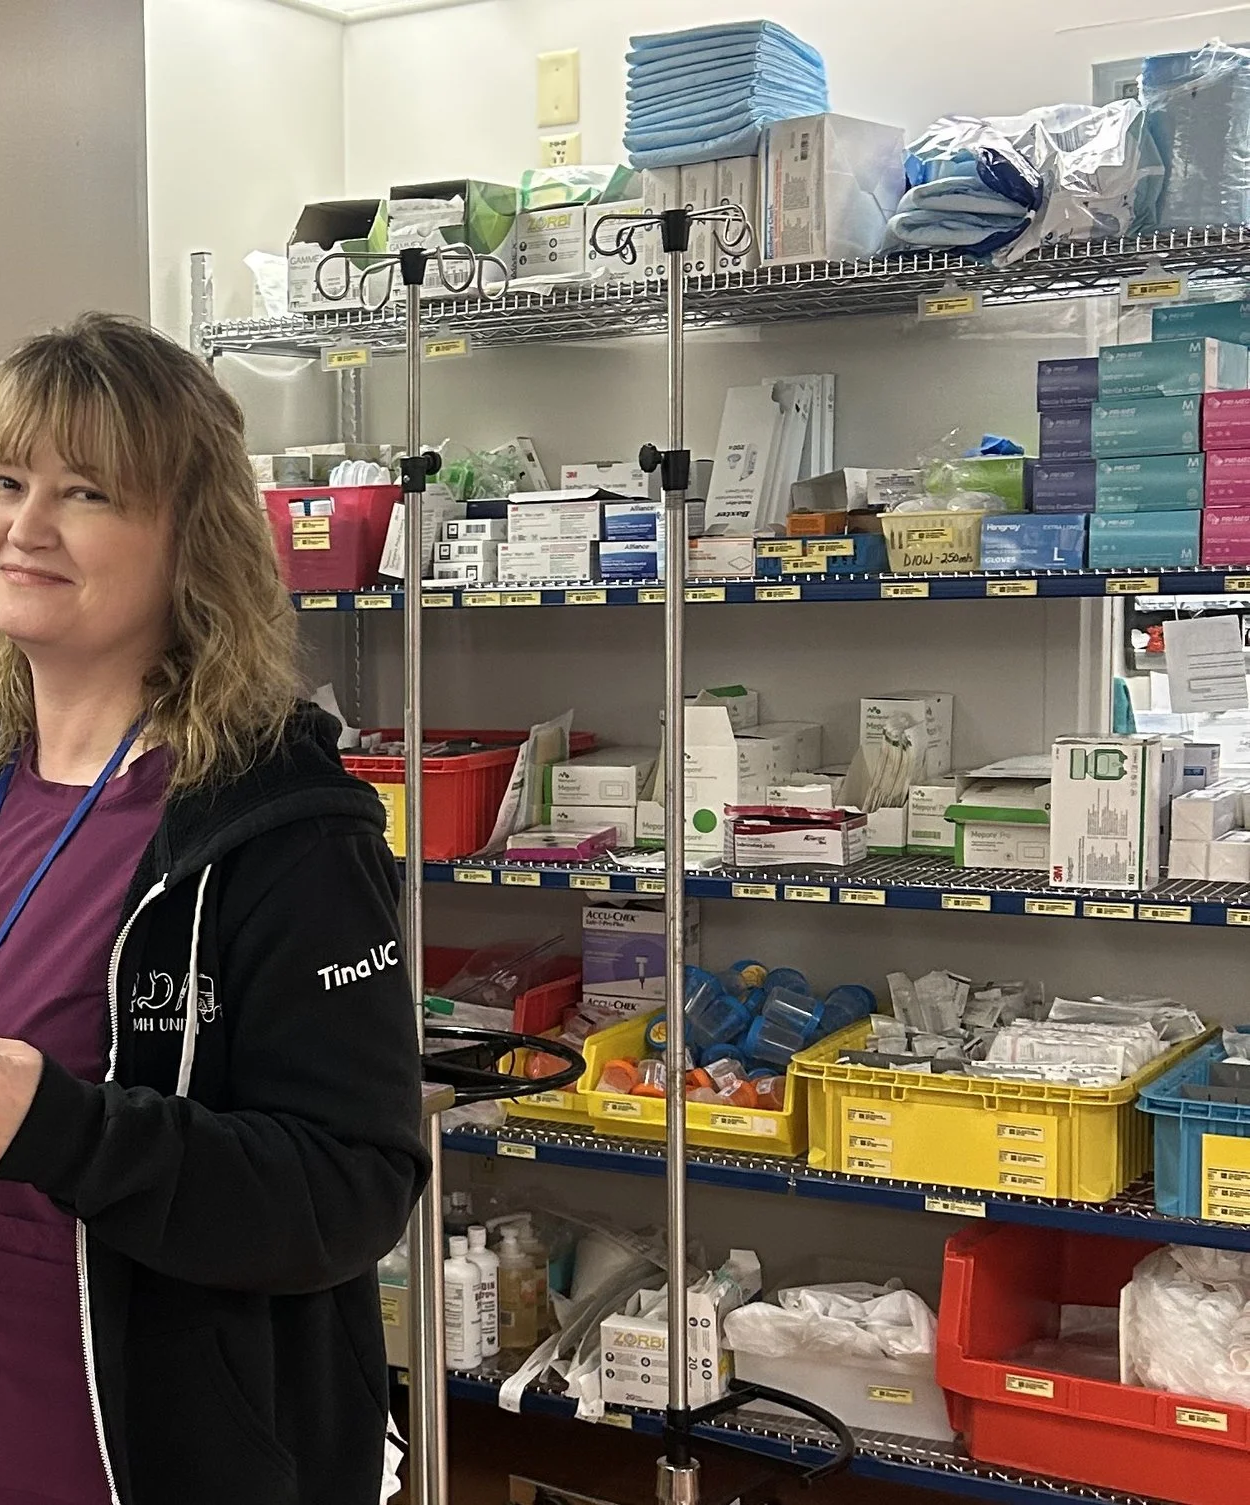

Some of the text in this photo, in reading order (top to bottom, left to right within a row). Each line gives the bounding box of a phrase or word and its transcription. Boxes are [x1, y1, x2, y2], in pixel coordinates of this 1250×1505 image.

[1189, 342, 1200, 352] M
[1182, 400, 1194, 410] M
[1187, 457, 1199, 467] M
[1053, 547, 1065, 561] L
[1181, 549, 1193, 559] M
[1053, 865, 1063, 882] 3M
[586, 910, 636, 922] ACCU-CHEK
[317, 940, 399, 991] Tina UC
[133, 1018, 154, 1033] MH
[613, 1331, 666, 1350] ZORBI
[688, 1356, 698, 1370] 20
